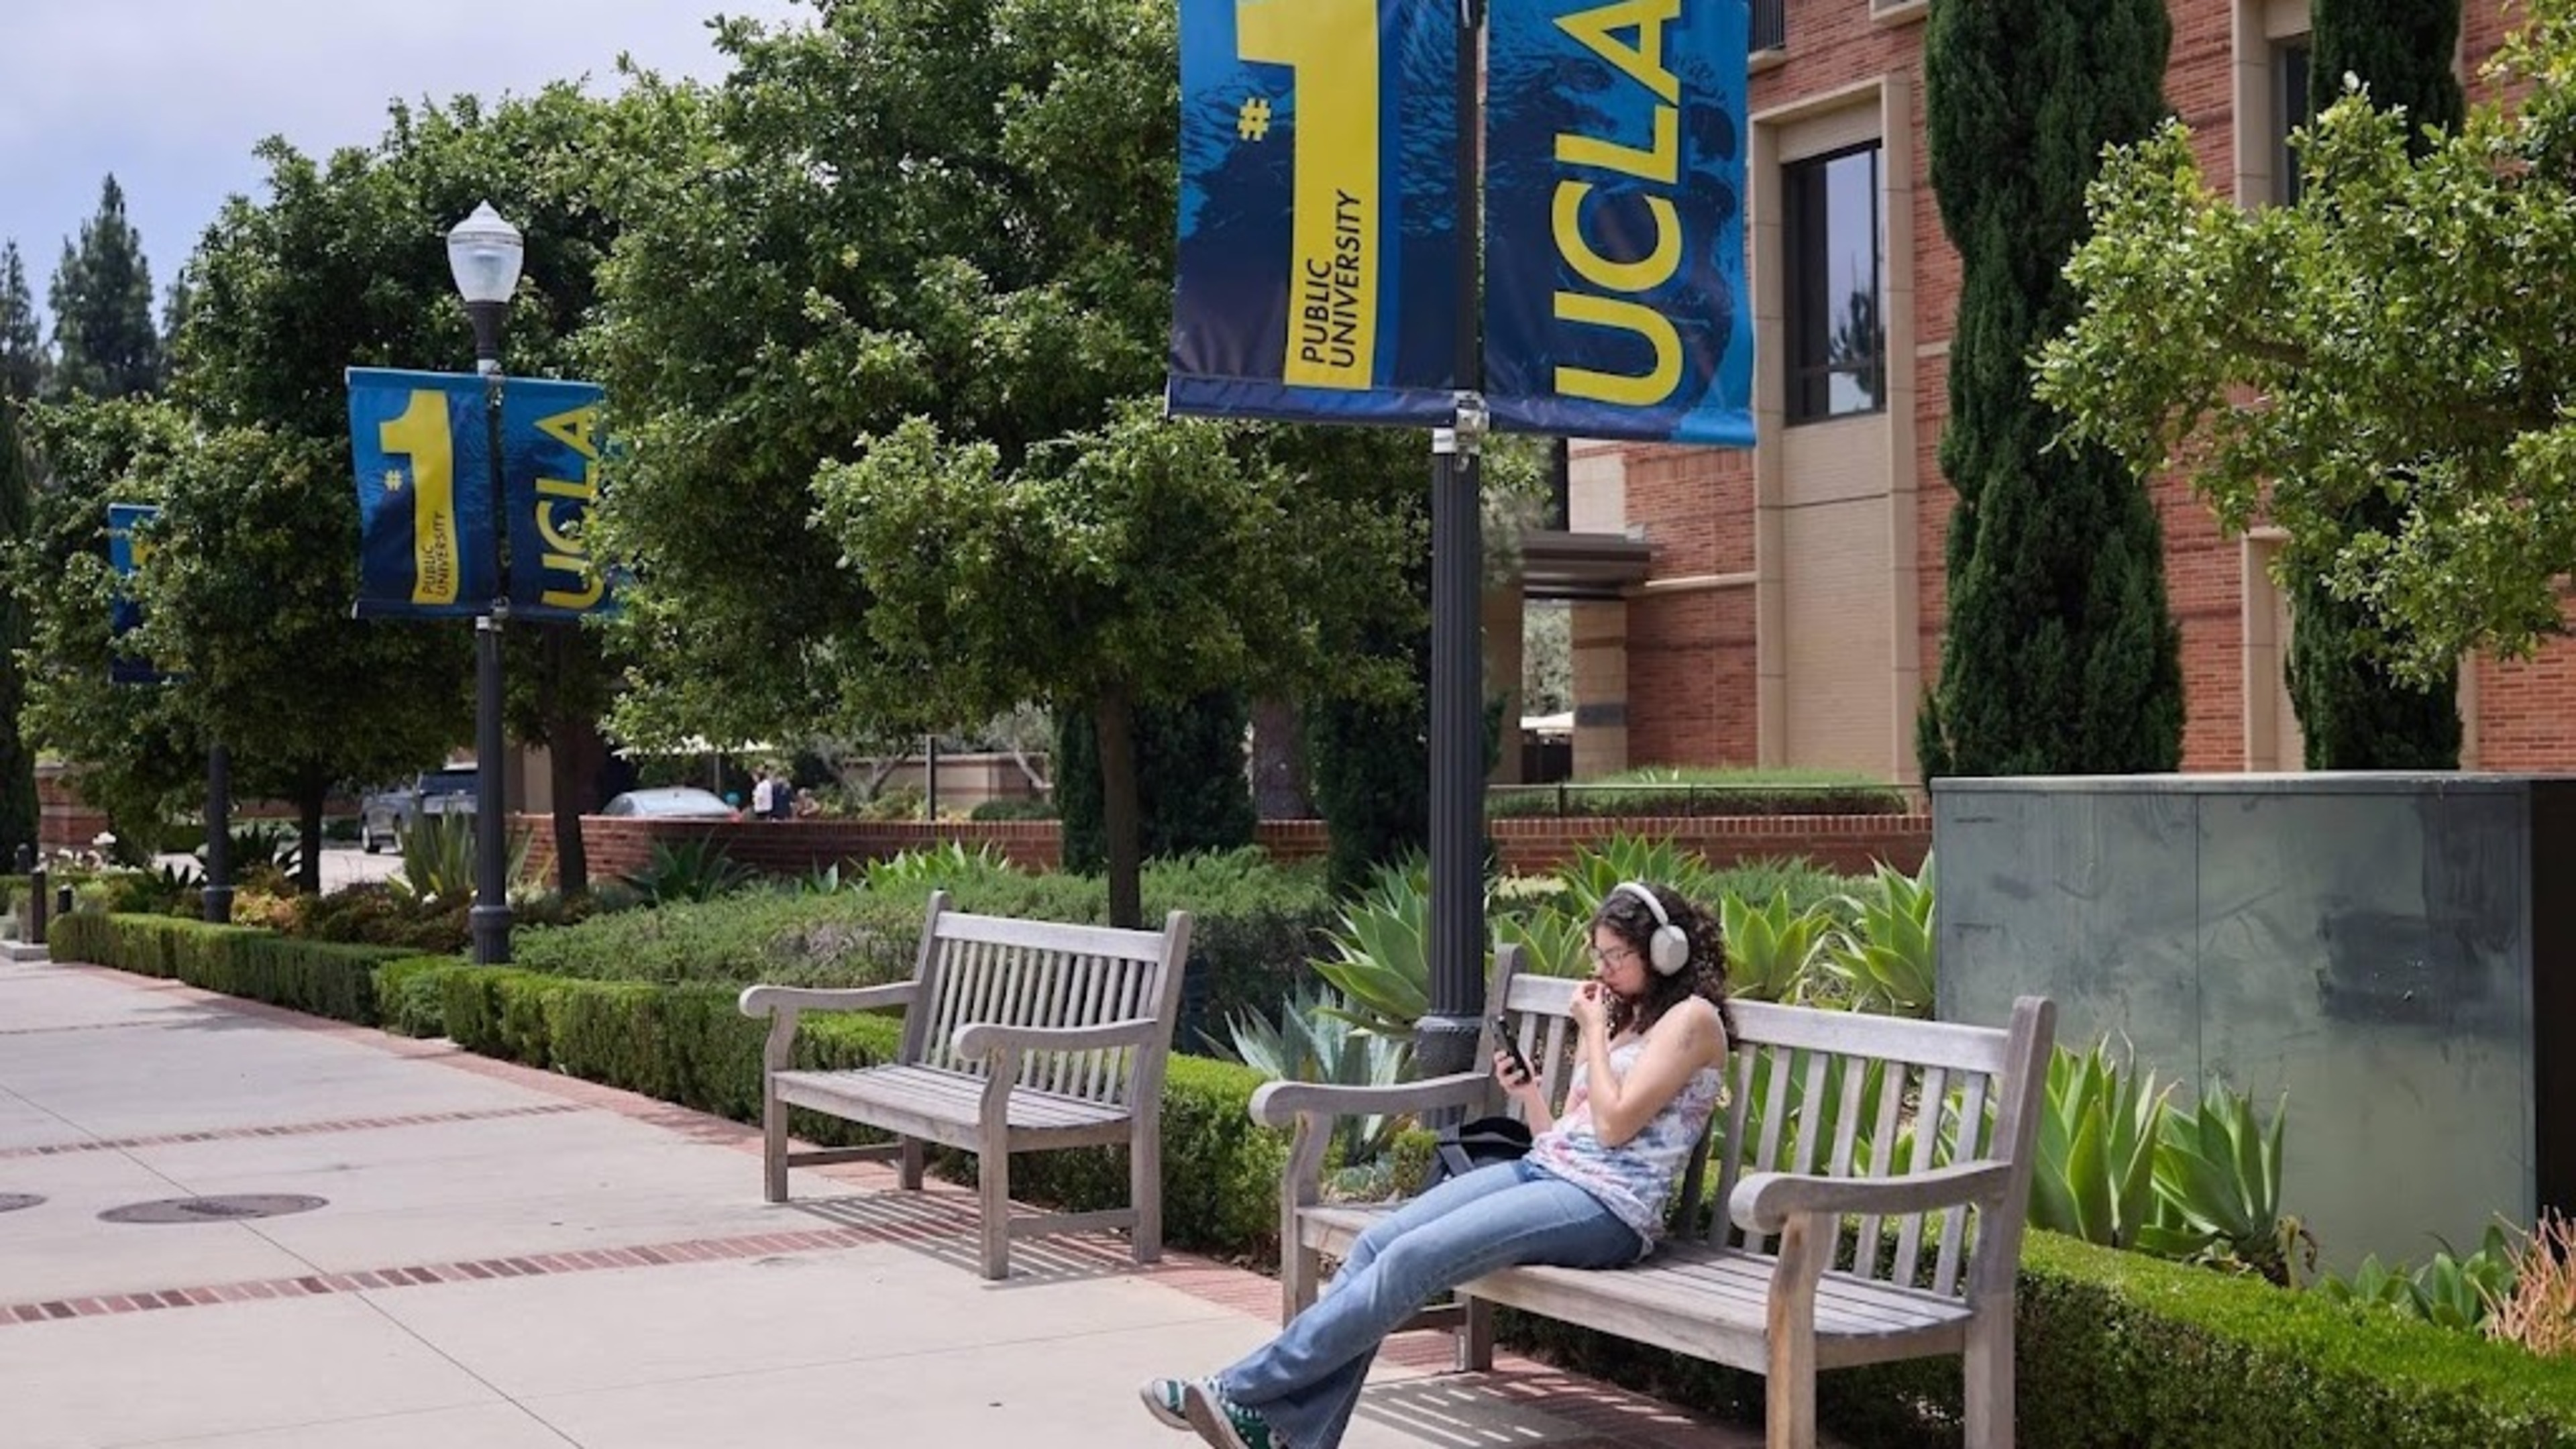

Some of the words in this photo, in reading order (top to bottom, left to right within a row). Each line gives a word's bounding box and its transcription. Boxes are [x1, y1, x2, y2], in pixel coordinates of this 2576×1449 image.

[1552, 0, 1682, 406] UCLA
[1300, 259, 1332, 364] PUBLIC
[1330, 189, 1361, 368] UNIVERSITY
[422, 545, 436, 594] PUBLIC
[433, 511, 449, 596] UNIVERSITY
